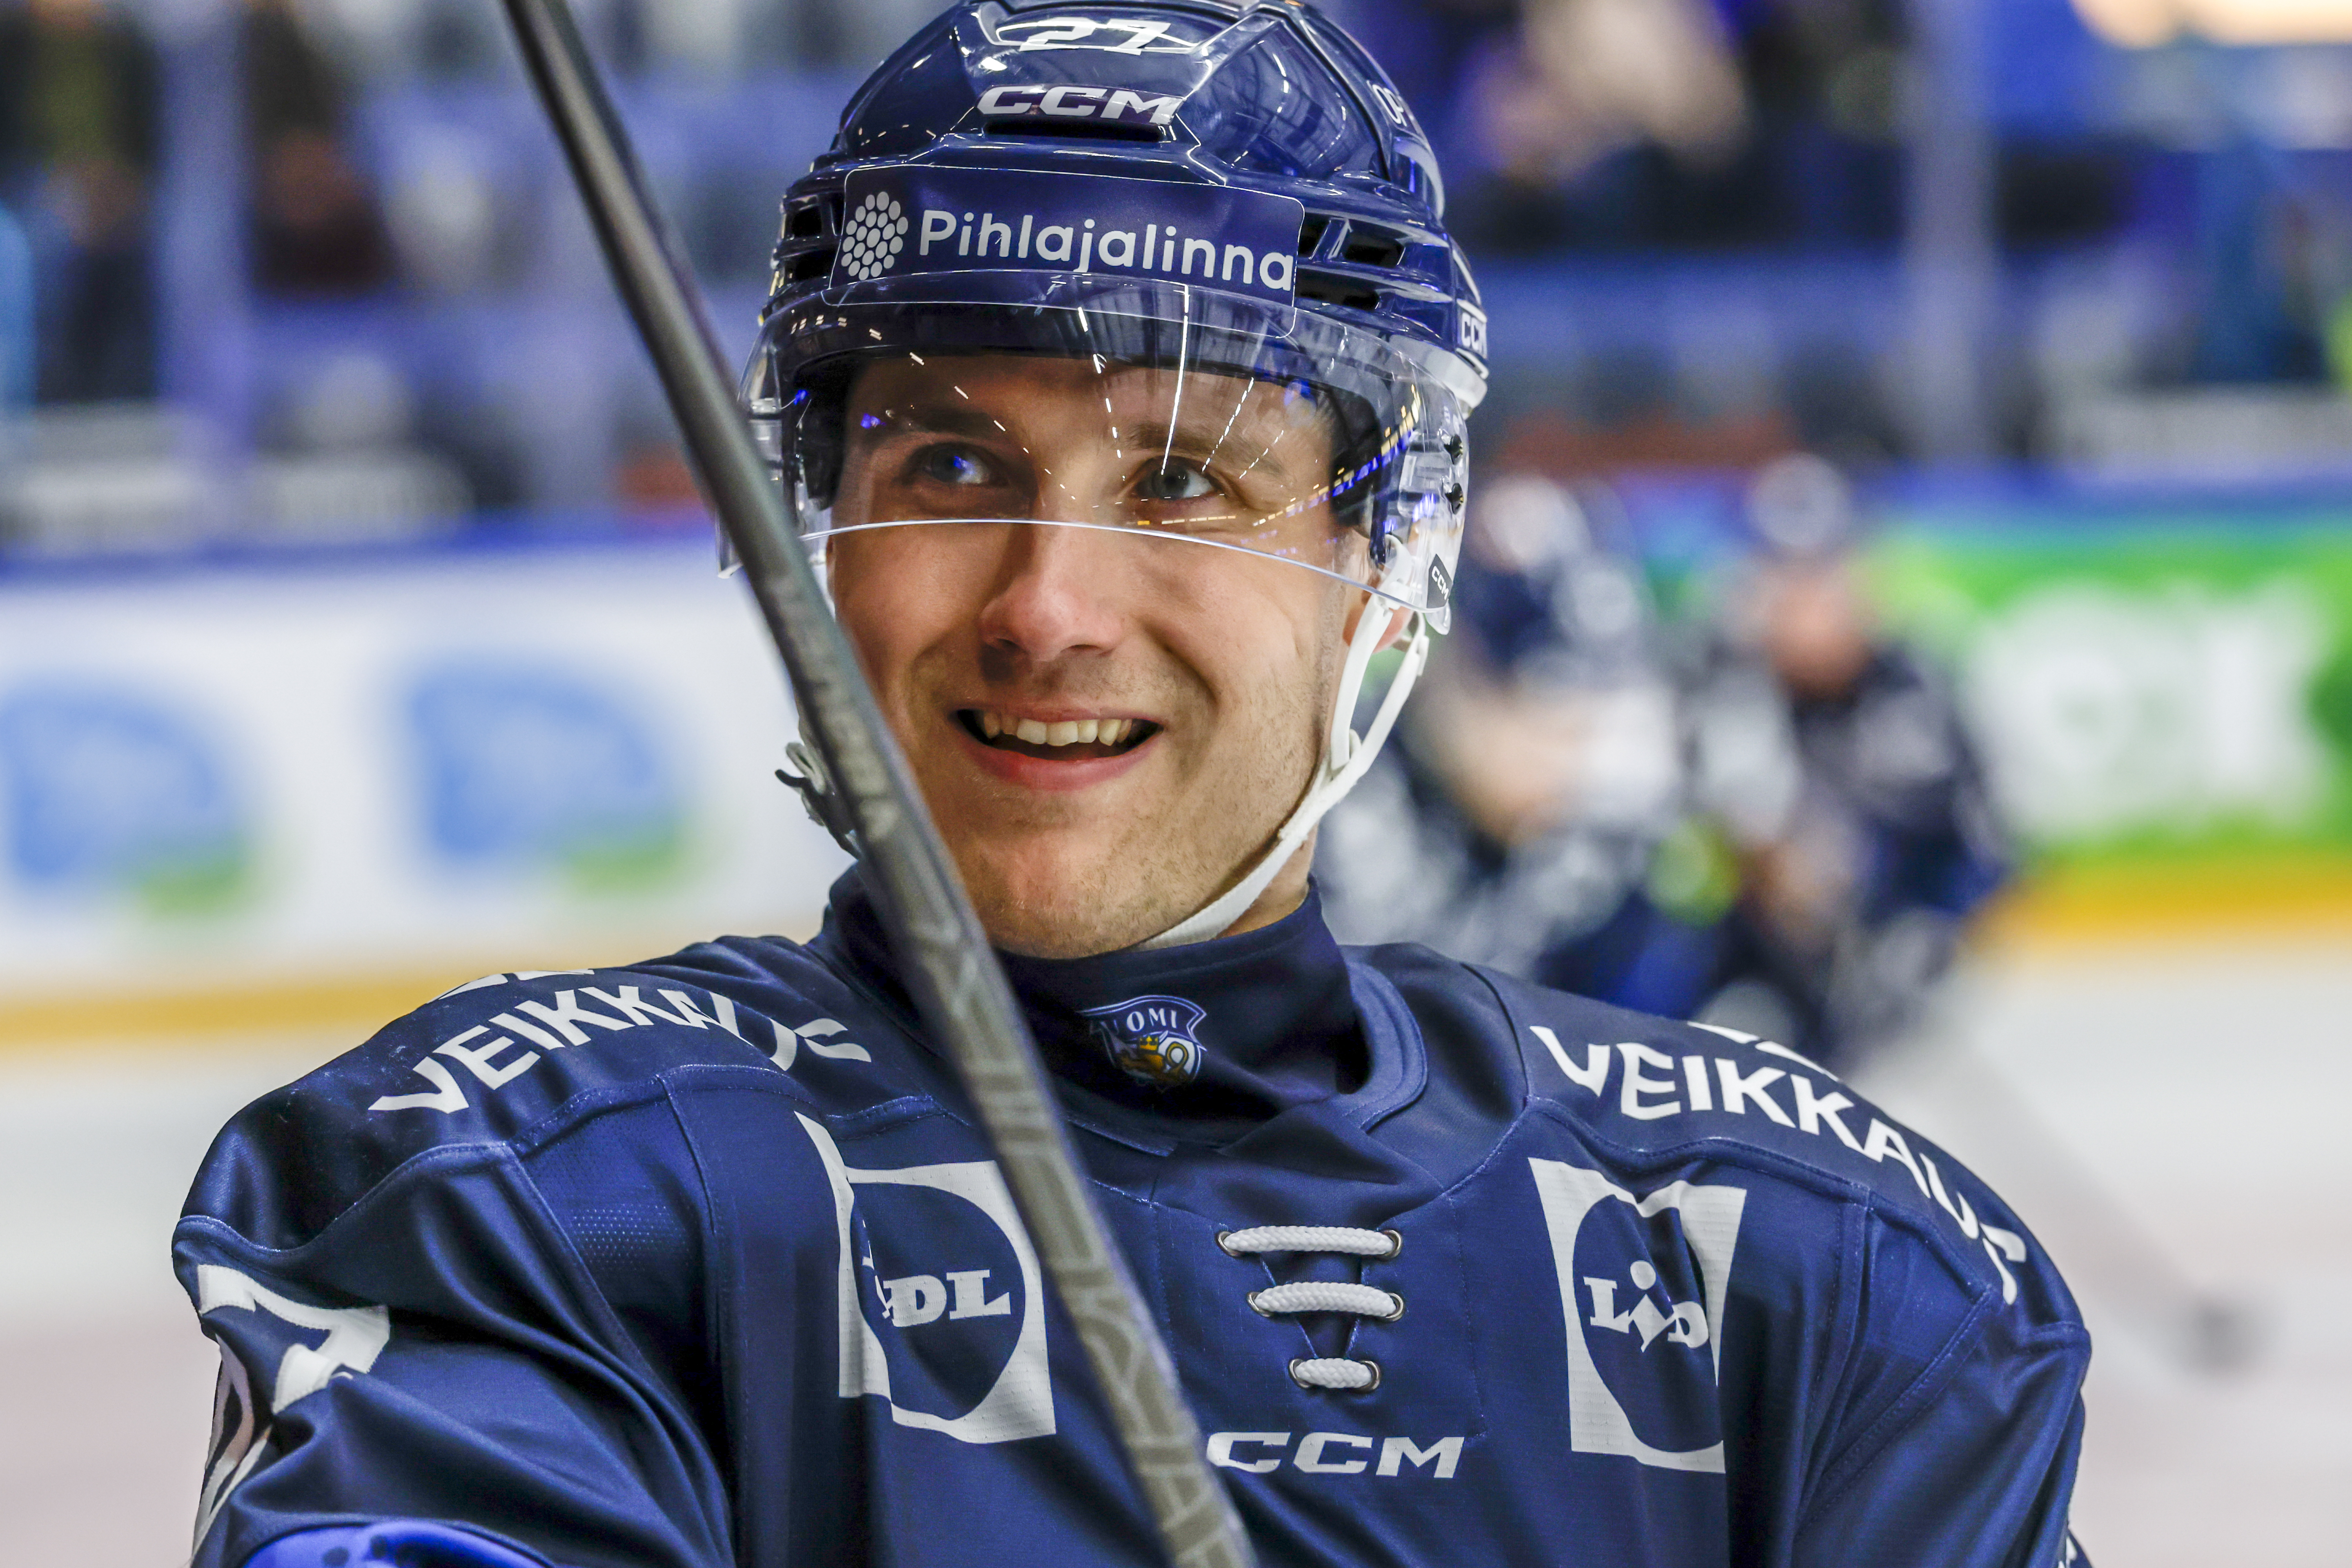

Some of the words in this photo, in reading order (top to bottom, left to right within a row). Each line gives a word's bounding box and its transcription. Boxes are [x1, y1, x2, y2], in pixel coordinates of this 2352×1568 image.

[1019, 16, 1171, 56] 27
[978, 86, 1185, 125] CCM
[919, 209, 1294, 292] Pihlajalinna
[1432, 566, 1449, 600] CCM
[368, 982, 871, 1114] VEIKKAUS
[1530, 1025, 2026, 1305] VEIKKAUS
[1206, 1432, 1465, 1479] CCM
